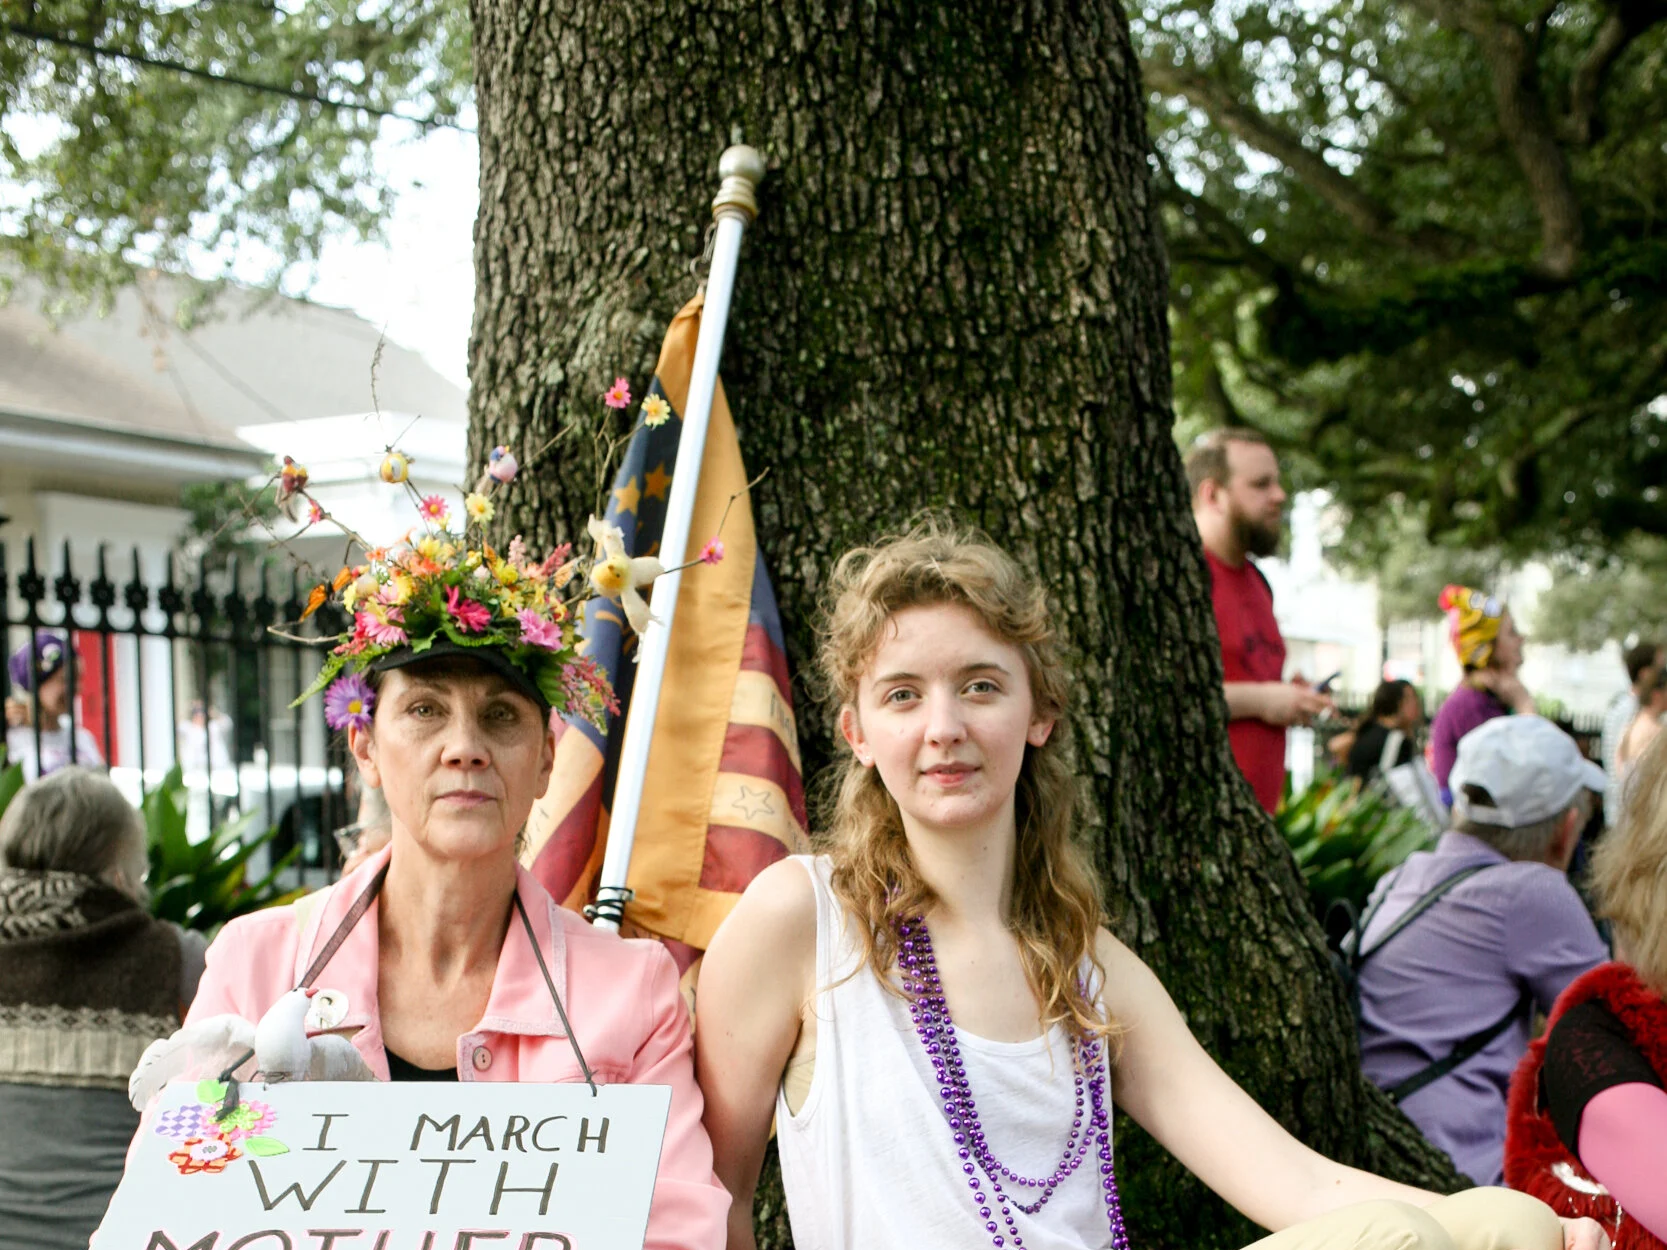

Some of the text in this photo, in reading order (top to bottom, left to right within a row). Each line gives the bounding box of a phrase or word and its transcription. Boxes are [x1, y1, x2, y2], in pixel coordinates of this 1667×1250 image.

[303, 1113, 610, 1154] I MARCH
[248, 1158, 559, 1216] WITH
